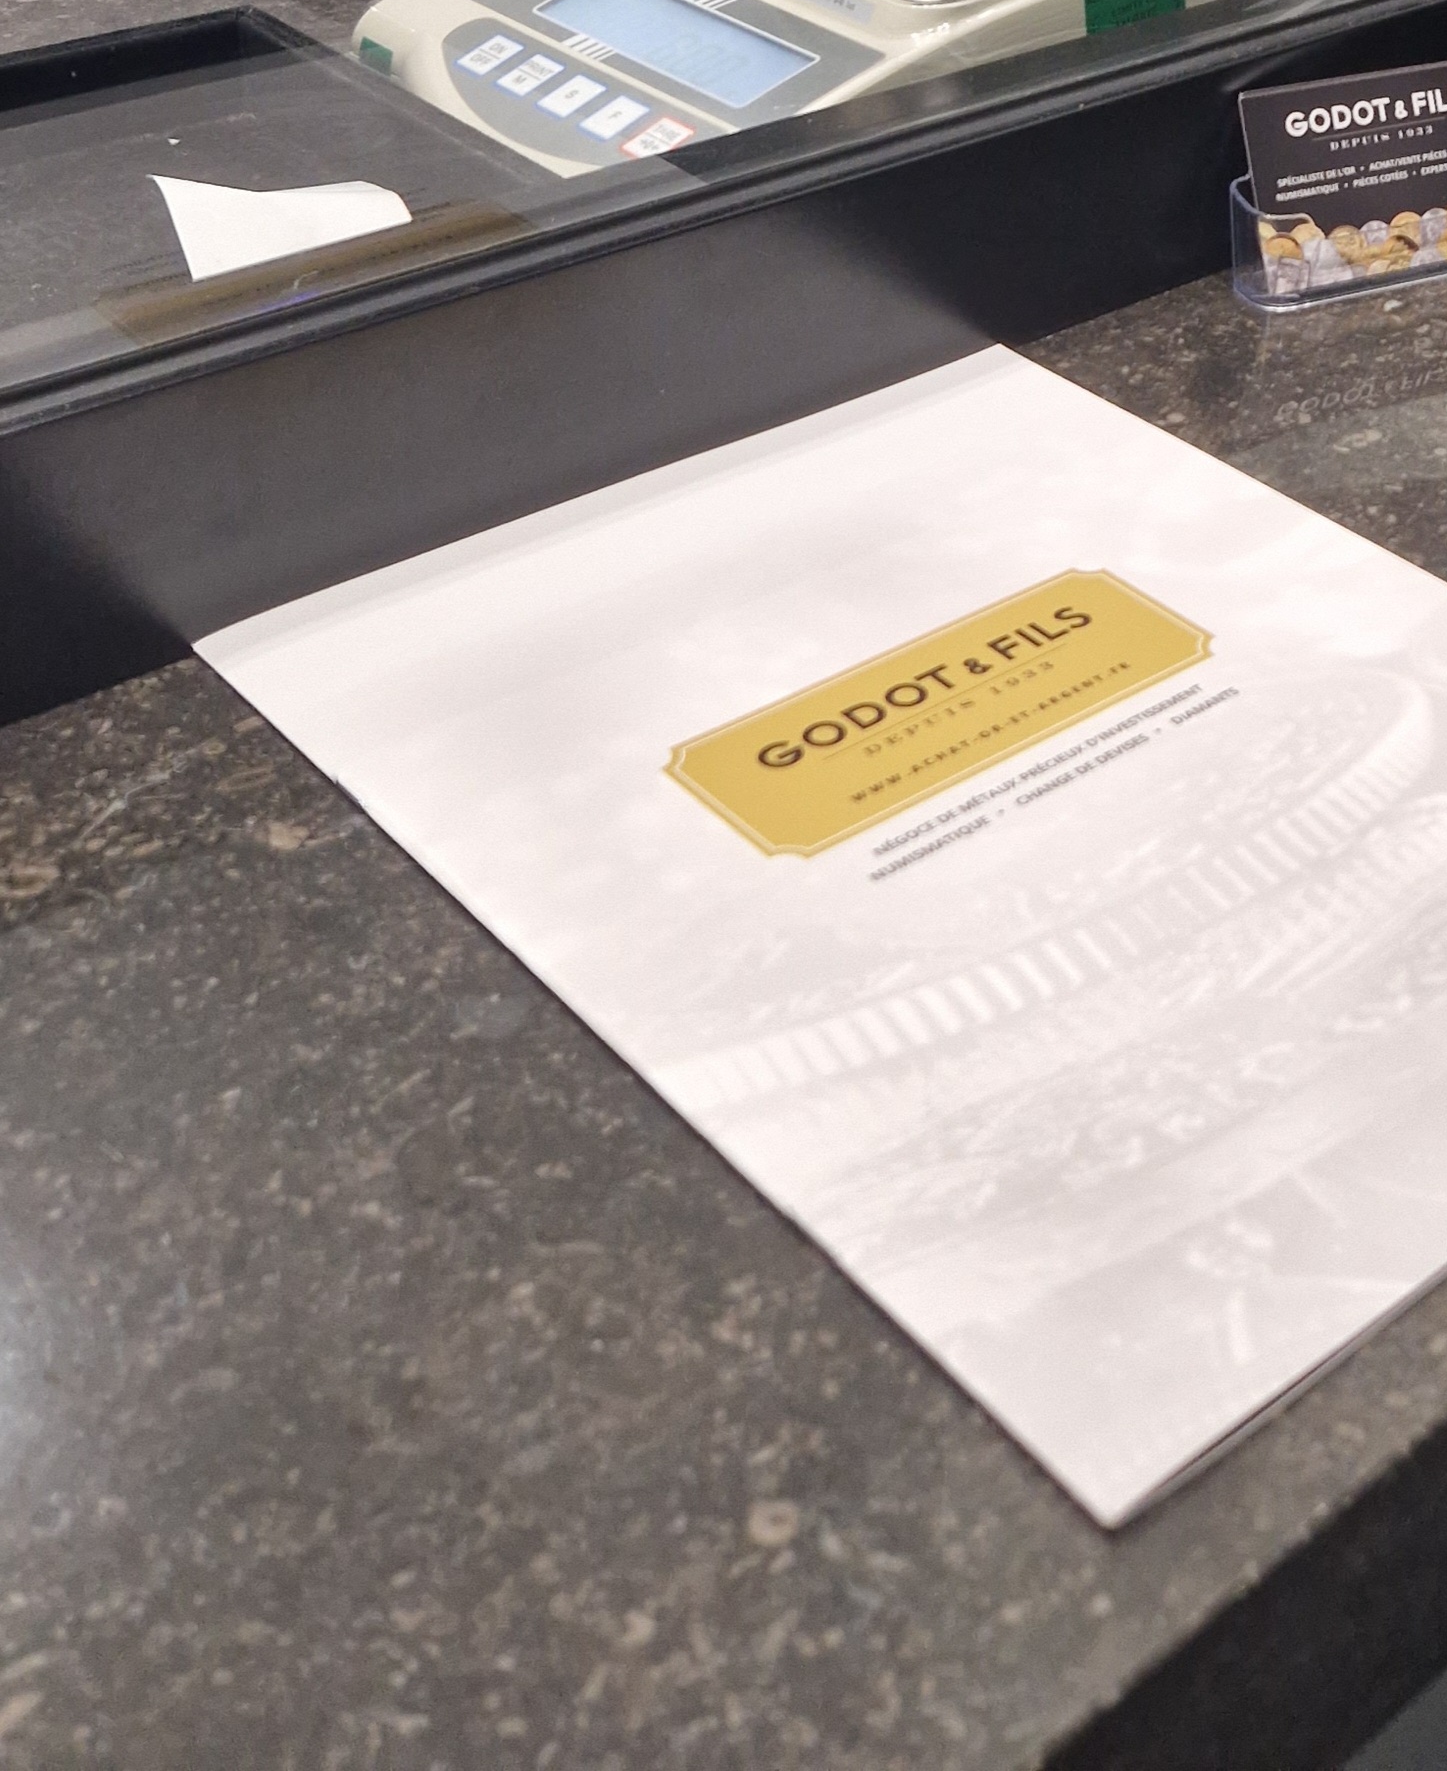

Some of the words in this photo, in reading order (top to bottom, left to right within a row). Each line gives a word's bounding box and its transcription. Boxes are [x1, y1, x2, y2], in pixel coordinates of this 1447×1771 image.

[1285, 96, 1391, 137] GODOT
[1394, 100, 1409, 119] &
[1329, 131, 1391, 151] DEPUIS
[757, 663, 956, 768] GODOT
[962, 656, 994, 676] &
[986, 605, 1093, 660] FILS
[863, 697, 977, 757] DEPUIS
[870, 815, 992, 883] NUMISMATIQUE
[1014, 771, 1075, 808] CHANGE
[1076, 759, 1097, 776] DE
[1097, 732, 1151, 766] DEVISES
[1169, 685, 1240, 726] DIAMANTS
[872, 820, 934, 858] NÉGOCE
[936, 808, 958, 824] DE
[958, 779, 1017, 815] MÉTAUX
[1019, 744, 1084, 782] PRÉCIEUX
[1086, 683, 1204, 748] D'INVESTISSEMENT
